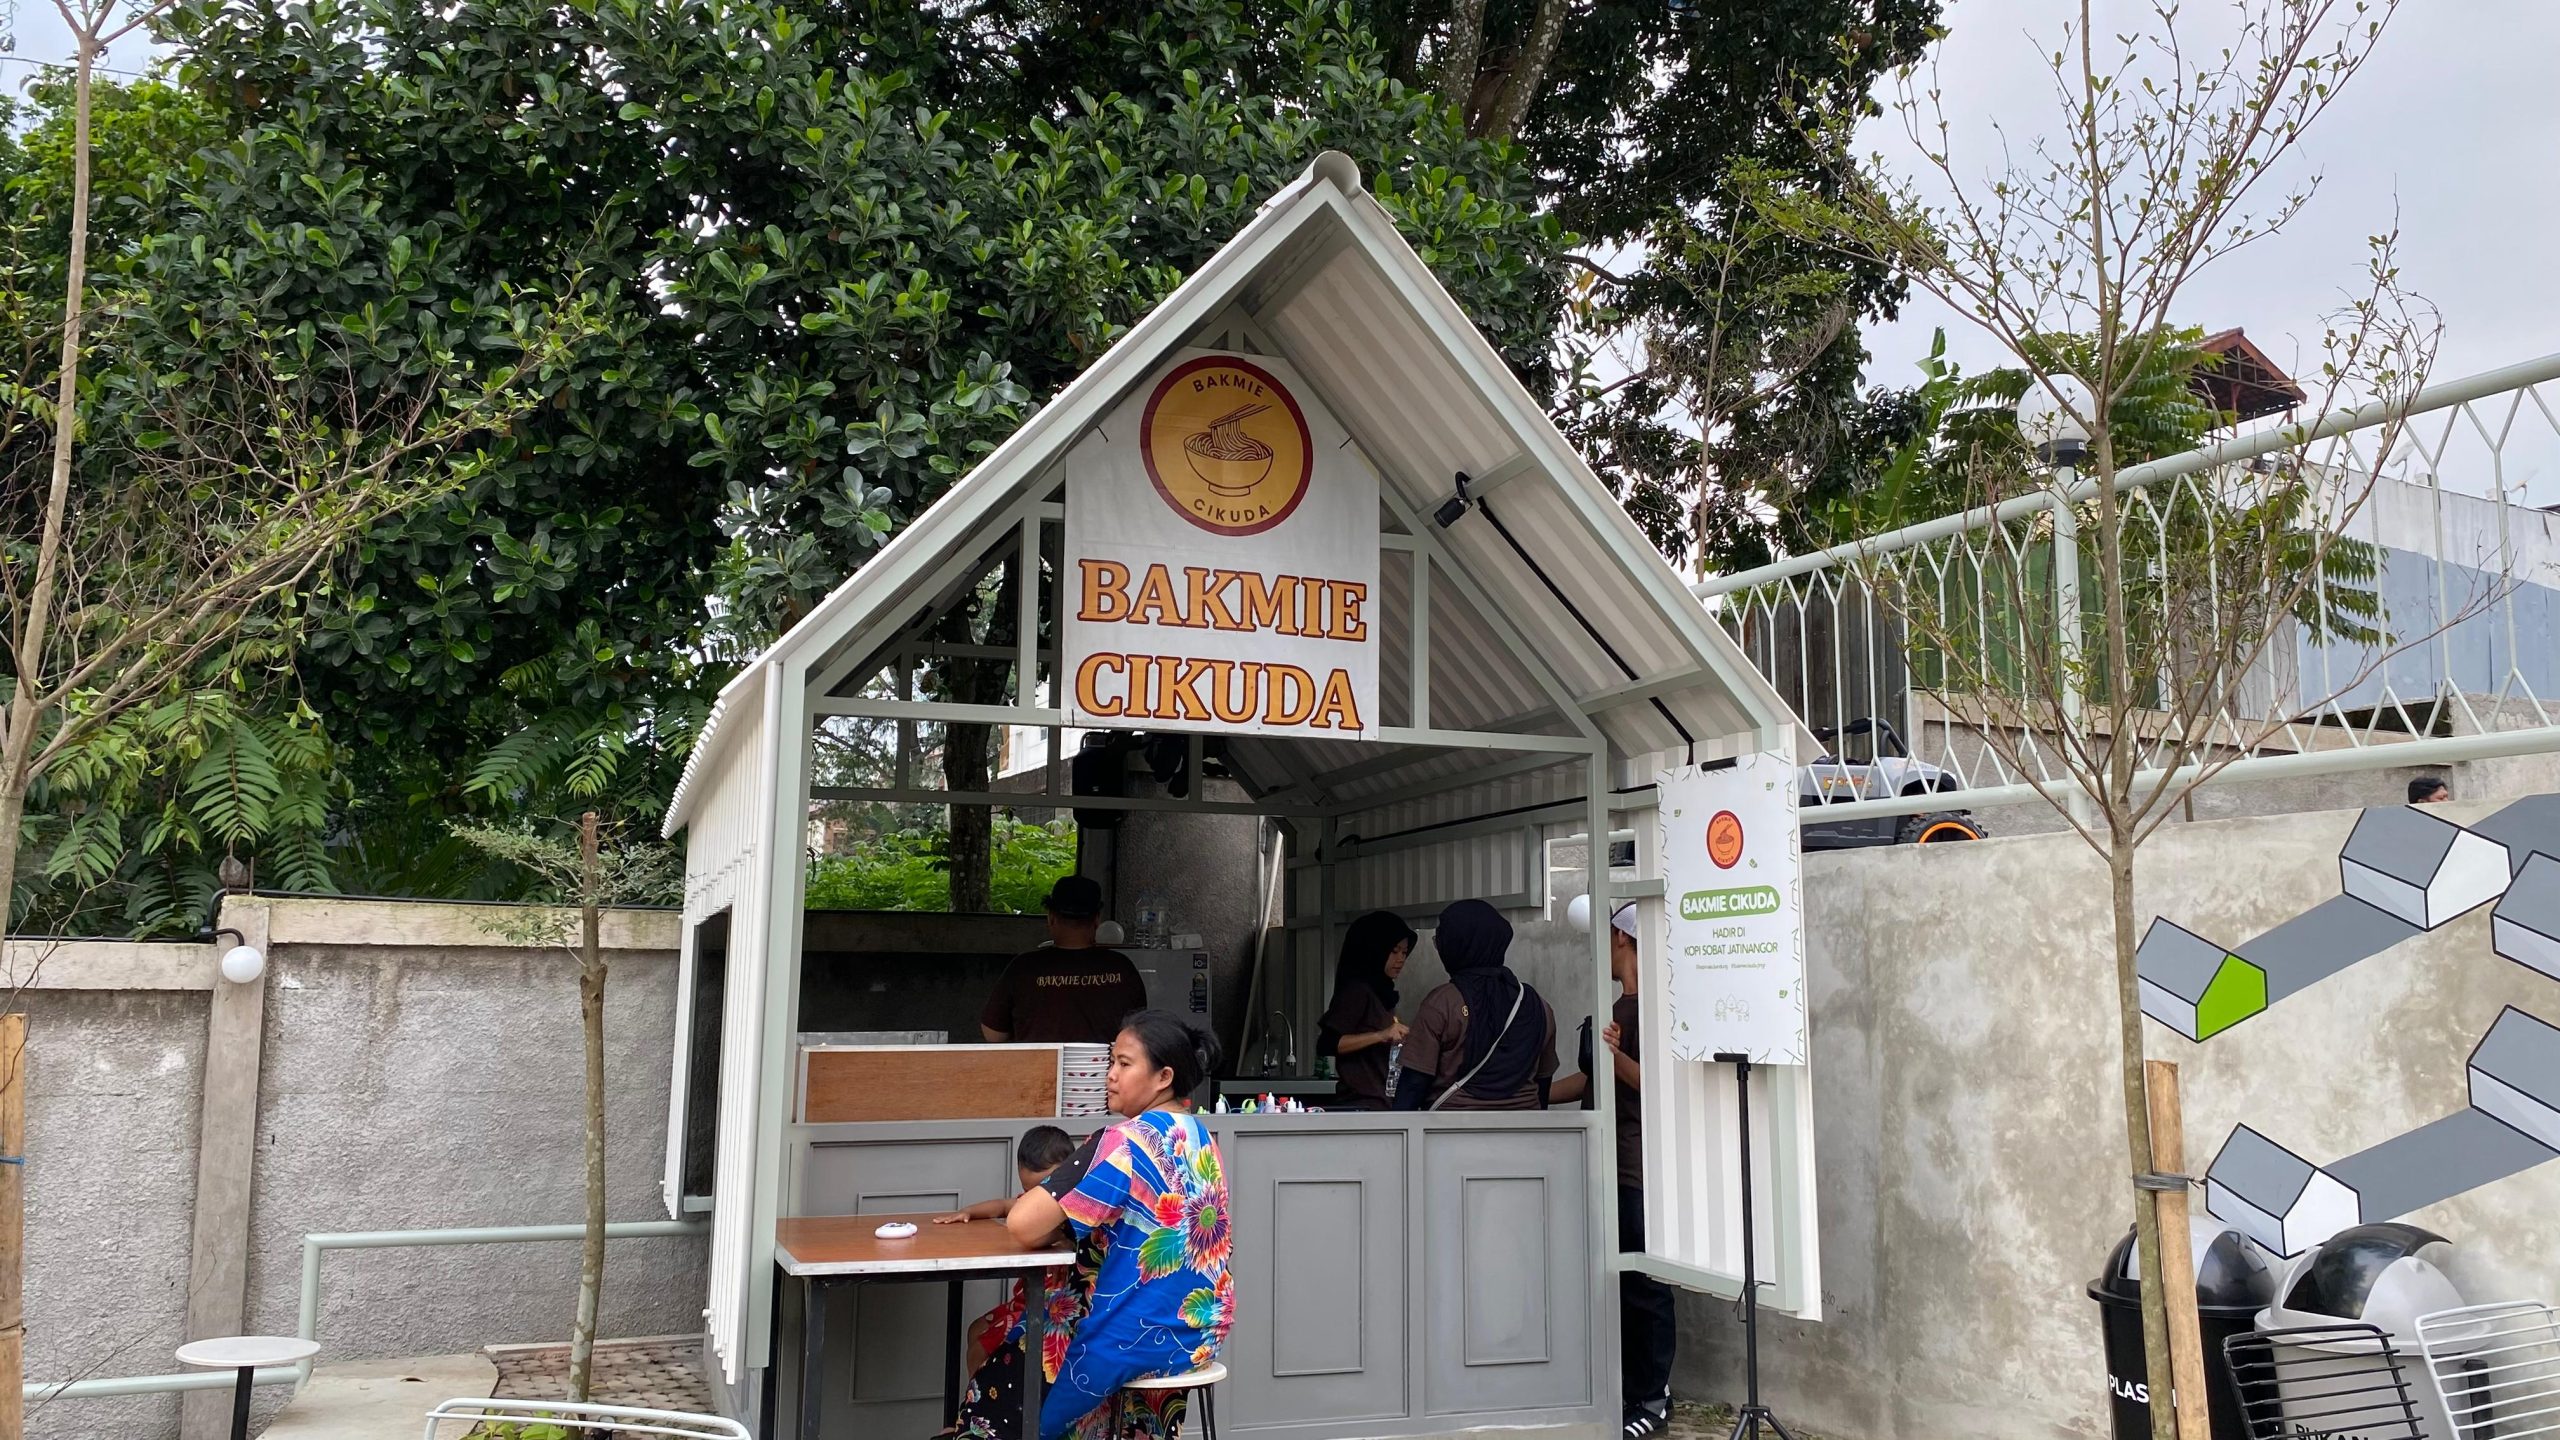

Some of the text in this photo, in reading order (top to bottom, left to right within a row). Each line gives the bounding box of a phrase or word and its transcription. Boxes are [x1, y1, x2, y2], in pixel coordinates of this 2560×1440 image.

[1192, 374, 1264, 397] BAKMIE
[1192, 498, 1270, 523] CIKUDA
[1077, 559, 1367, 642] BAKMIE
[1075, 652, 1364, 731] CIKUDA
[1682, 892, 1777, 914] BAKMIE CIKUDA
[1712, 927, 1746, 938] HADIR DI
[1684, 942, 1778, 956] KOPI SOBAT JATINANGOR
[1036, 972, 1121, 987] BAKMIE CIKUDA
